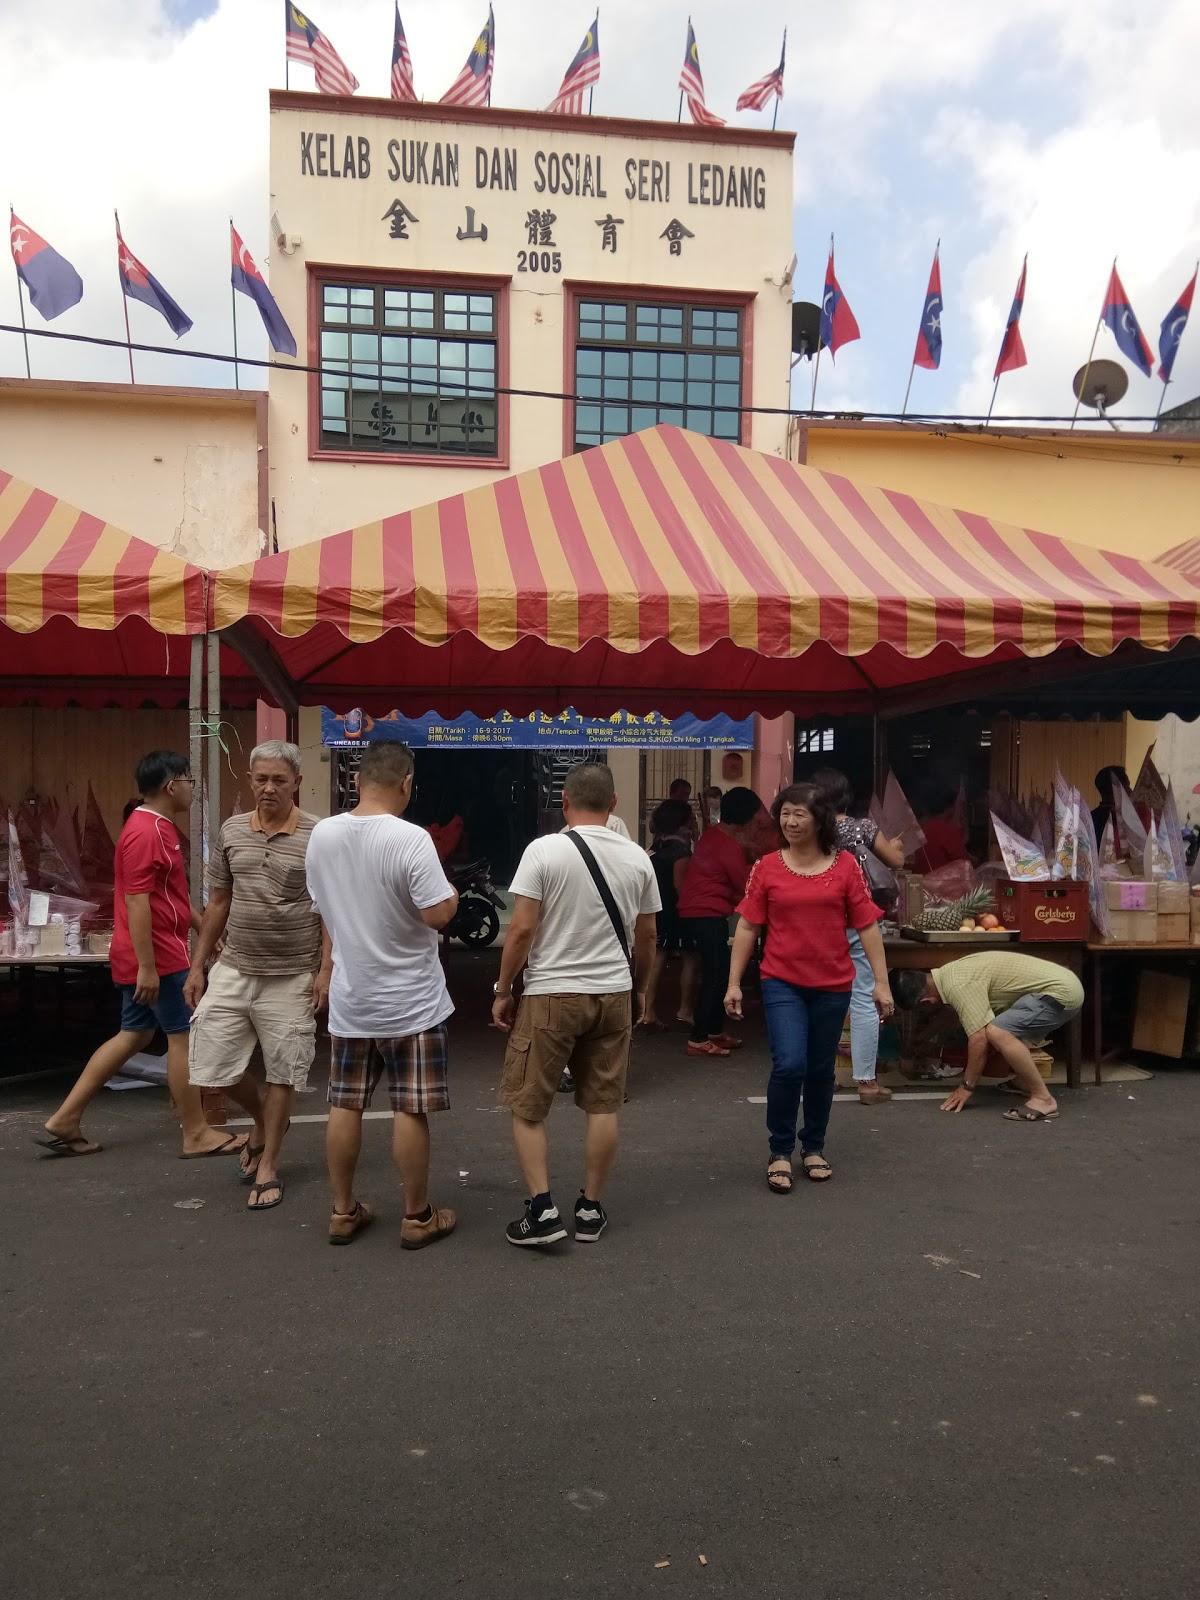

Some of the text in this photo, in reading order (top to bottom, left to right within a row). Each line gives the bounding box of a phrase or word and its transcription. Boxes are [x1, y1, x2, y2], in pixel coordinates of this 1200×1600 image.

[300, 131, 766, 209] KELAB SUKAN DAN SOSIAL SERI LEDANG
[381, 198, 695, 257] 金山體育會
[517, 250, 562, 273] 2005
[613, 736, 647, 744] Serbaguna
[685, 736, 701, 744] Ming
[709, 736, 736, 744] Tangkak
[1035, 906, 1076, 922] Carlsberg
